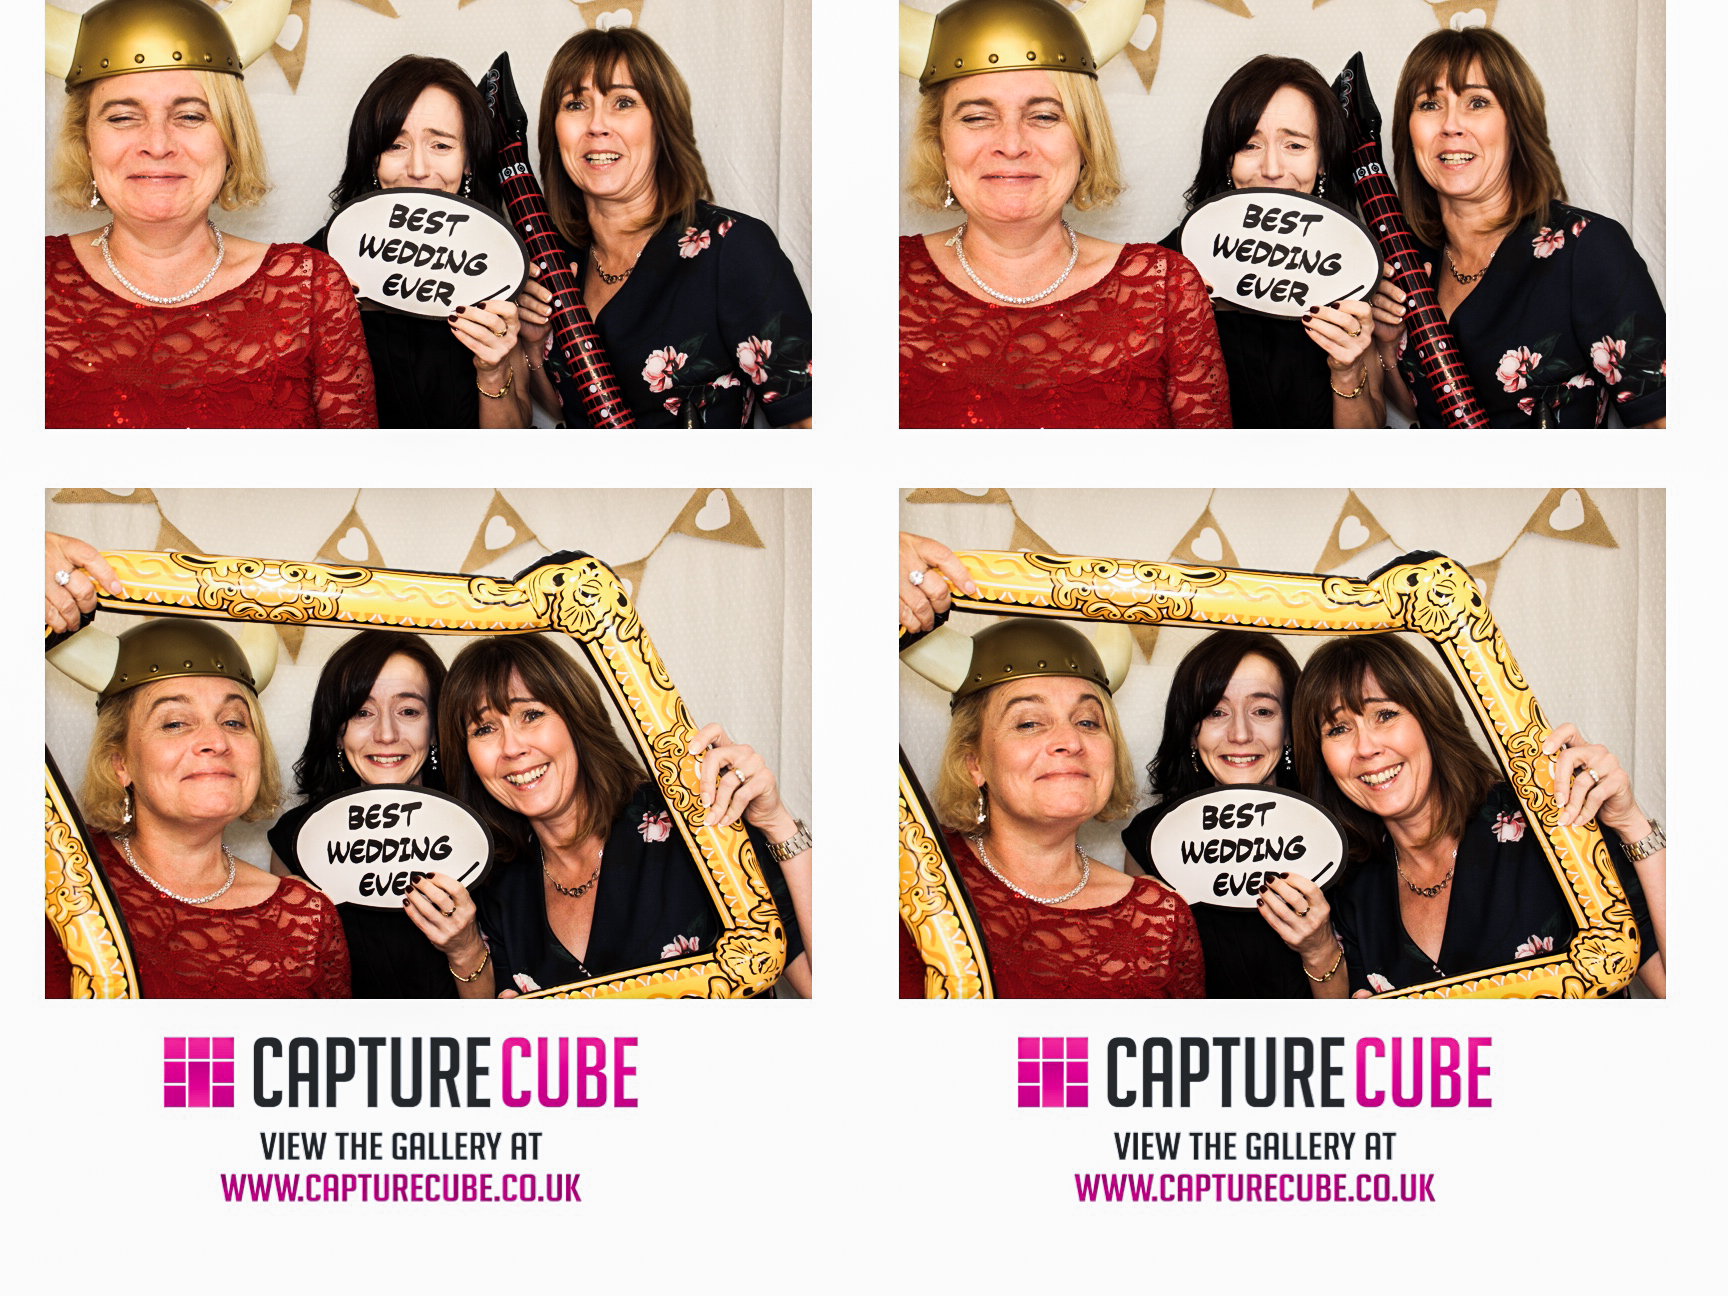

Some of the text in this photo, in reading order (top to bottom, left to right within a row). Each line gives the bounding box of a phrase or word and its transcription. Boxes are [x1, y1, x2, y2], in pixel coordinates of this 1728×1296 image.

[388, 203, 470, 237] BEST
[1242, 203, 1324, 237] BEST
[358, 233, 488, 276] WEDDING
[1212, 233, 1342, 276] WEDDING
[382, 273, 456, 307] EVER
[1236, 273, 1310, 307] EVER
[348, 801, 423, 831] BEST
[1202, 801, 1277, 831] BEST
[327, 835, 453, 865] WEDDING
[1181, 835, 1307, 865] WEDDING
